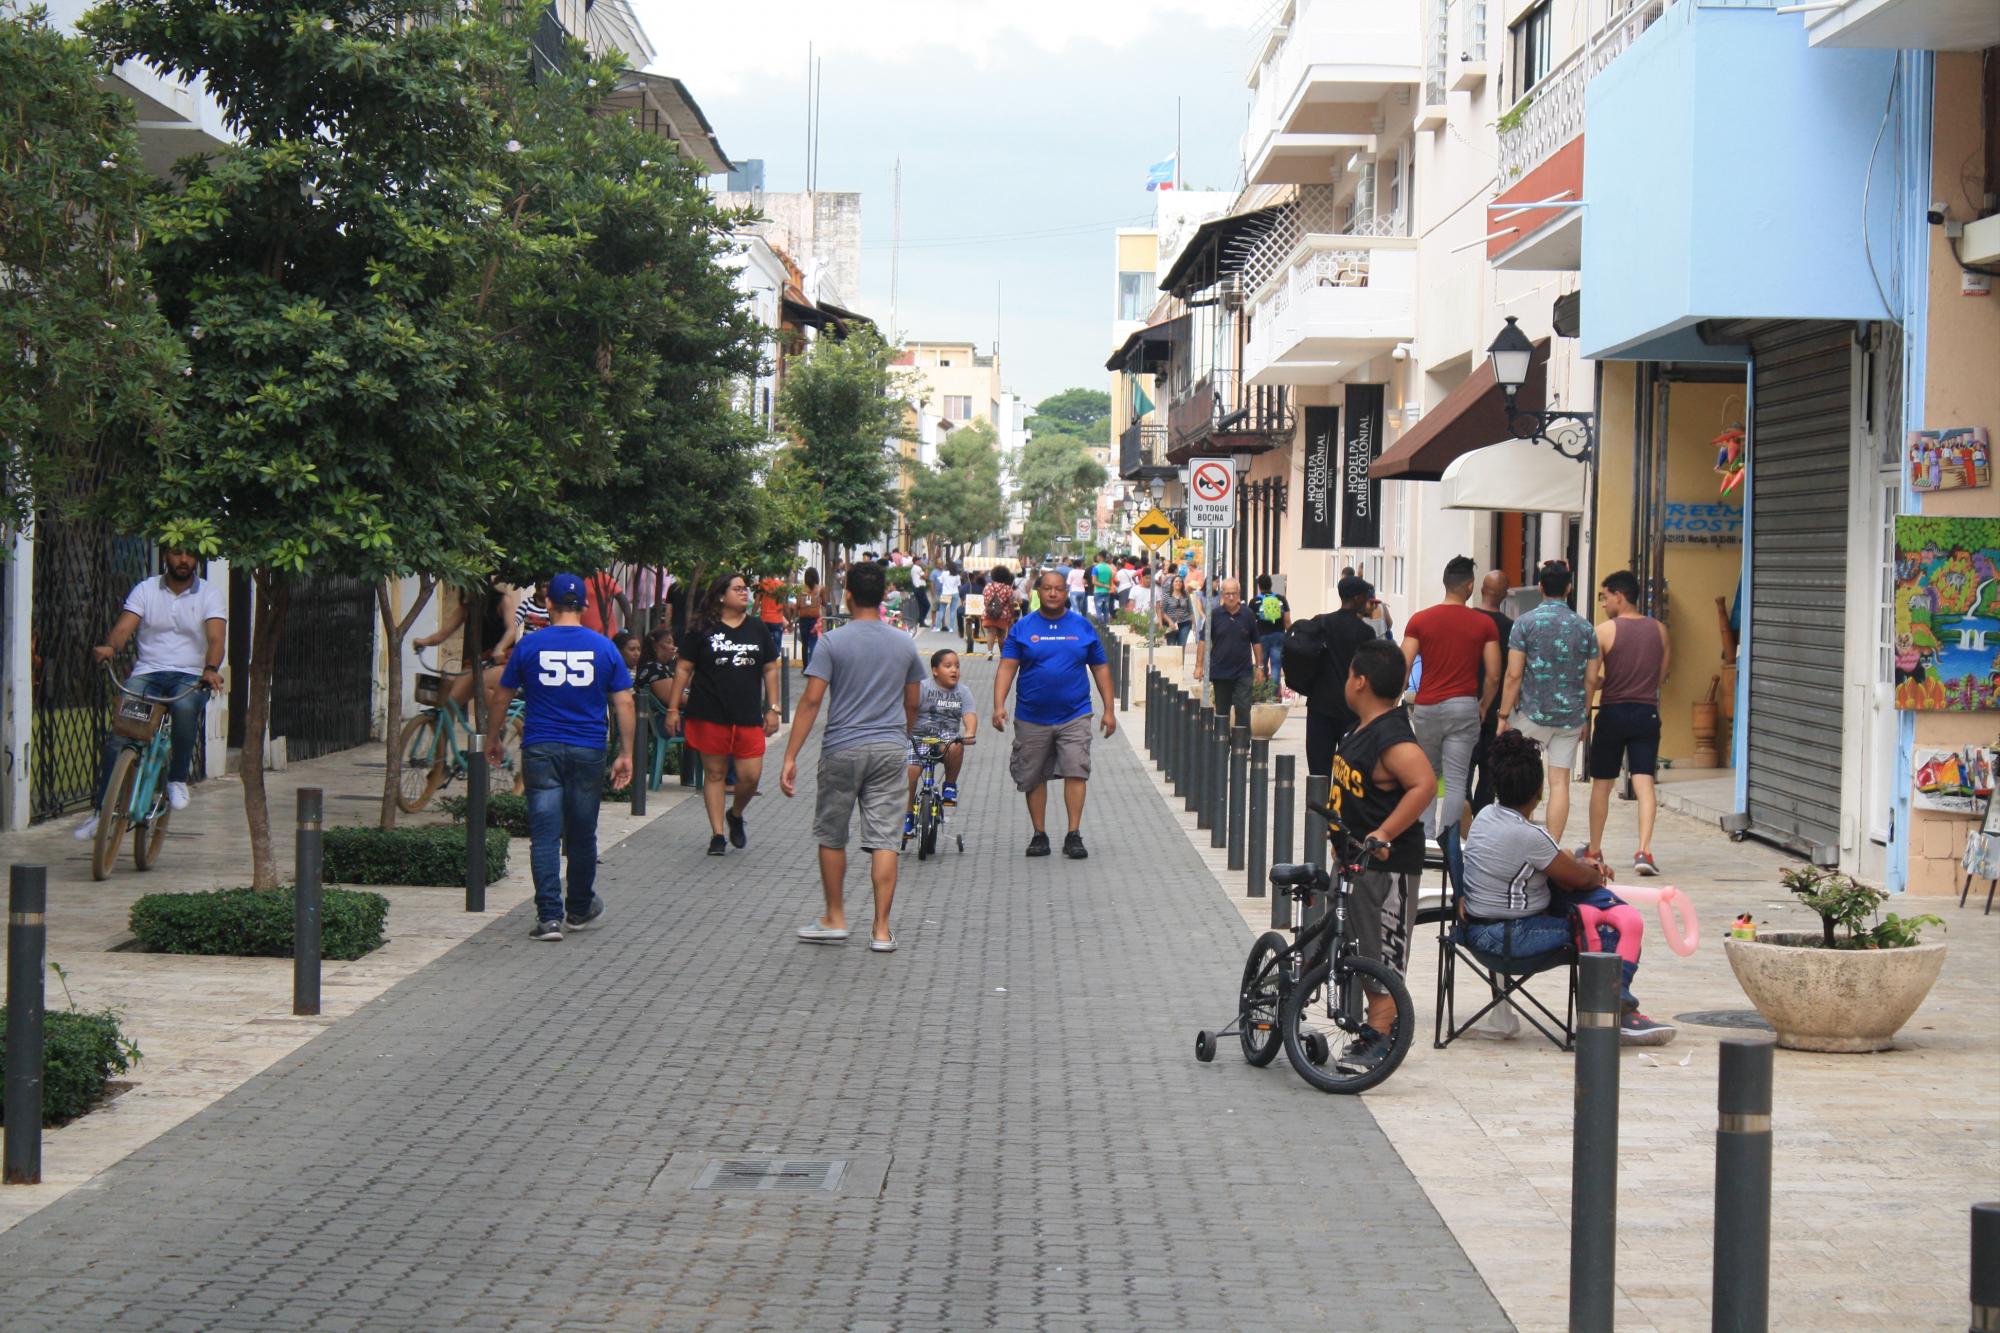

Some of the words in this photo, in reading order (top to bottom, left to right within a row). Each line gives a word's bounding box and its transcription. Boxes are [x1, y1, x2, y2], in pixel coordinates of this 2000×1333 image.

[1316, 433, 1326, 486] COLONIAL
[1348, 439, 1359, 493] HODELPA
[1358, 415, 1370, 475] COLONIAL
[1307, 454, 1317, 501] HODELPA
[1356, 475, 1367, 517] CARIBE
[1193, 504, 1204, 512] NO
[1206, 504, 1229, 512] TOQUE
[1197, 513, 1224, 522] BOCINA
[1315, 487, 1325, 522] CARIBE
[538, 650, 595, 687] 55
